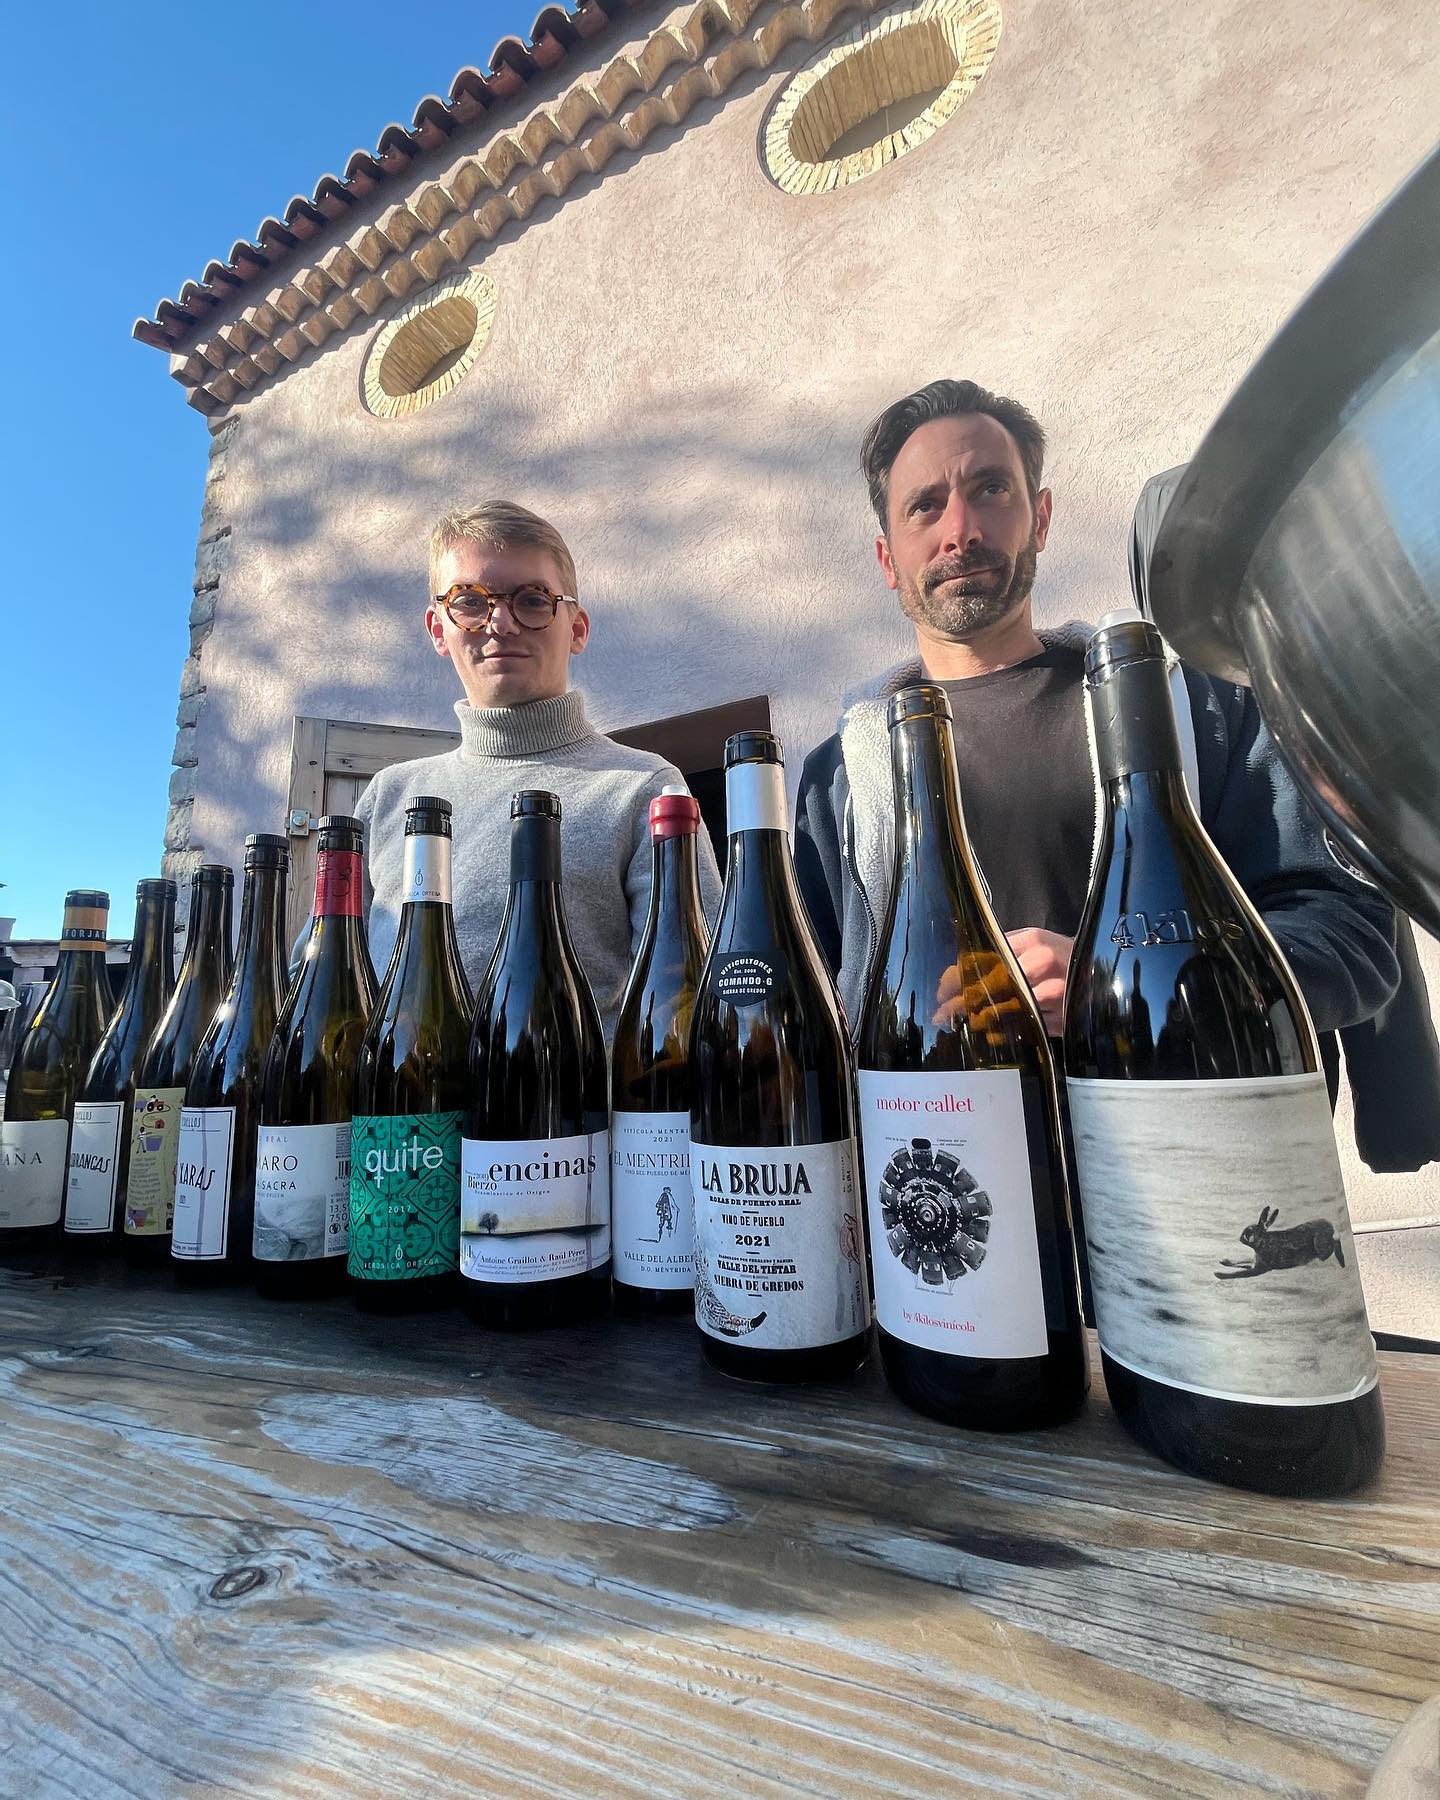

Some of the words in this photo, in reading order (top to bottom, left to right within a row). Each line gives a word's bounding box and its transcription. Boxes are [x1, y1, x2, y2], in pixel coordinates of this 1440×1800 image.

[720, 958, 773, 976] VITICULTORES
[876, 1097, 920, 1112] motor
[924, 1094, 976, 1113] callet
[366, 1135, 443, 1189] quite
[489, 1152, 596, 1182] encinas
[614, 1150, 624, 1166] EL
[626, 1152, 690, 1168] MENTRI
[262, 1181, 296, 1191] SACRA
[467, 1175, 498, 1191] Bierzo
[701, 1160, 724, 1194] LA
[728, 1162, 813, 1197] BRUJA
[731, 1198, 741, 1206] DE
[742, 1199, 777, 1207] PUERTO
[778, 1198, 801, 1207] REAL
[722, 1213, 738, 1226] VINO
[740, 1216, 751, 1226] DE
[753, 1216, 785, 1227] PUEBLO
[735, 1234, 771, 1248] 2021
[480, 1254, 505, 1264] Antoine
[507, 1256, 537, 1264] Graillot
[624, 1251, 645, 1262] VALLE
[647, 1255, 663, 1263] DEL
[717, 1260, 741, 1273] VALLE
[742, 1263, 760, 1274] DEL
[714, 1274, 743, 1290] SIERRA
[745, 1280, 759, 1292] DE
[761, 1280, 804, 1293] GREDOS
[903, 1308, 912, 1324] by
